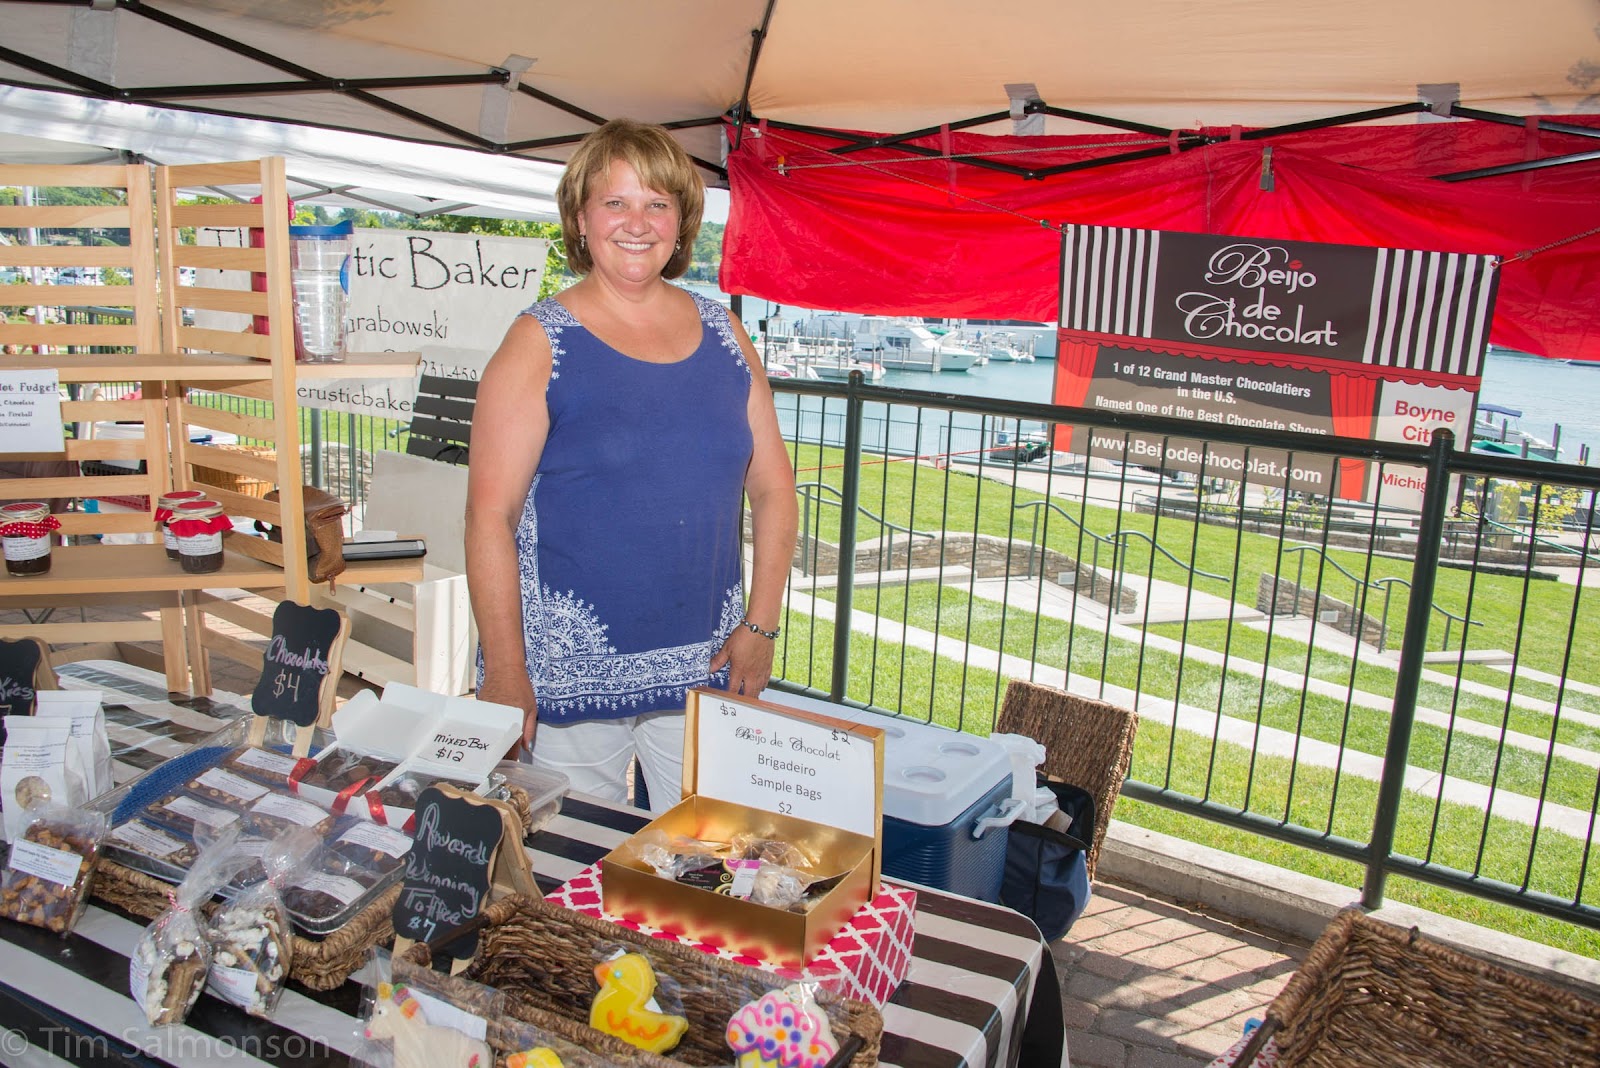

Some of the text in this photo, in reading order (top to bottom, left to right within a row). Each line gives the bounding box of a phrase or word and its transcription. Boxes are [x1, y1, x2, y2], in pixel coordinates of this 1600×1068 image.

[407, 236, 537, 290] Baker
[1204, 243, 1317, 294] Beijo
[1242, 287, 1281, 321] de
[1175, 291, 1338, 347] Chocolat
[1113, 362, 1311, 398] 1 of 12 Grand Master Chocolatiers
[1177, 386, 1236, 405] in the U.S.
[1095, 395, 1132, 411] Named
[1136, 401, 1158, 414] One
[1161, 404, 1173, 416] of
[1176, 406, 1194, 419] the
[1197, 408, 1222, 424] Best
[1226, 413, 1285, 431] Chocolate
[1395, 400, 1455, 423] Boyne
[1403, 425, 1432, 444] Cit
[272, 668, 301, 702] $4
[720, 703, 737, 717] $2
[735, 726, 841, 761] Beijo de Chocolat
[831, 729, 851, 745] $2
[435, 746, 465, 763] $12
[757, 753, 816, 777] Brigadeiro
[750, 774, 822, 801] Sample Bags
[778, 801, 793, 815] $2
